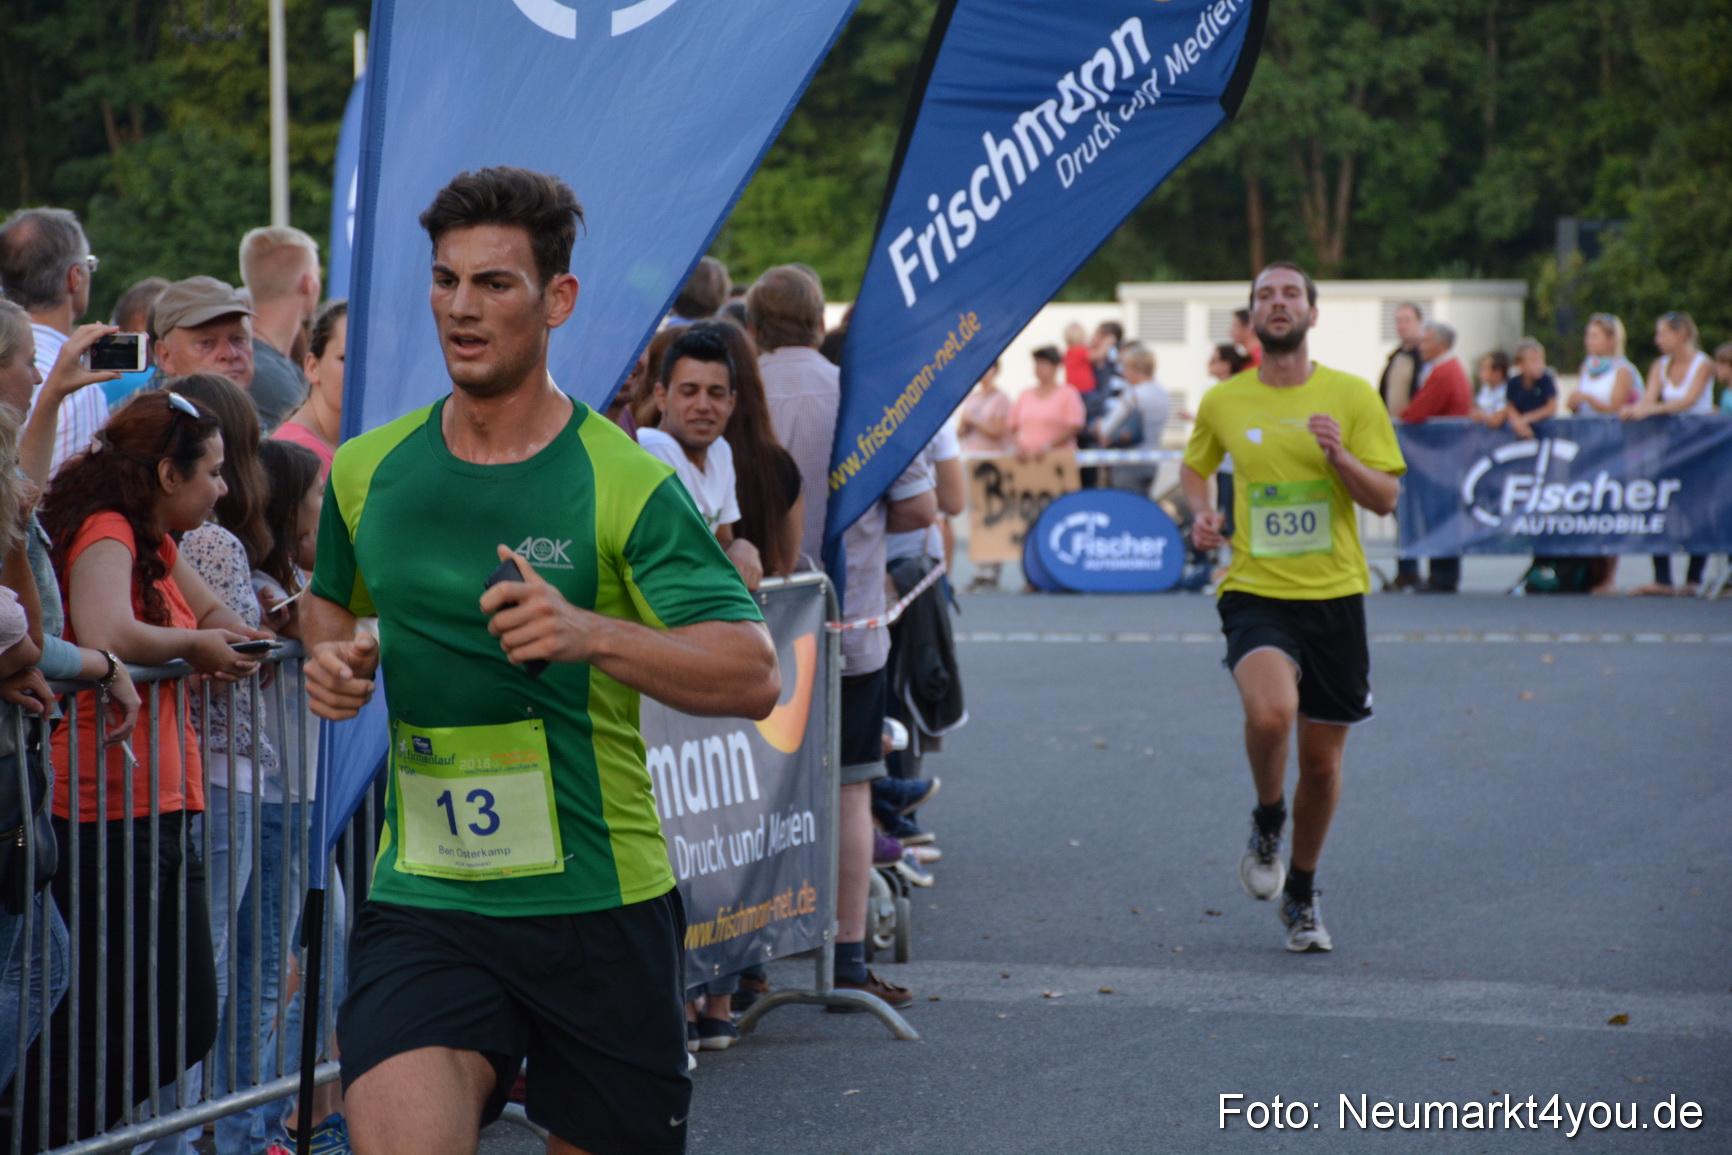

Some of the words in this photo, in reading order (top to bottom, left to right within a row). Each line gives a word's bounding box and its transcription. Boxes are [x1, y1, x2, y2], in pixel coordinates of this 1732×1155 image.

[888, 16, 1151, 308] Frischmann
[1056, 109, 1121, 189] Druck
[828, 311, 982, 498] ww.frischmann-net.de
[1501, 470, 1682, 516] Fischer
[1265, 510, 1317, 537] 630
[1511, 513, 1666, 535] AUTOMOBILE
[513, 536, 574, 563] AOK
[1071, 531, 1168, 560] Fischer
[1083, 558, 1164, 571] AUTOMOBILE
[459, 758, 492, 770] 2016
[646, 730, 760, 820] mann
[436, 788, 501, 837] 13
[438, 844, 455, 856] Ben
[456, 847, 512, 859] Osterkamp
[674, 825, 726, 880] Druck
[729, 814, 765, 867] und
